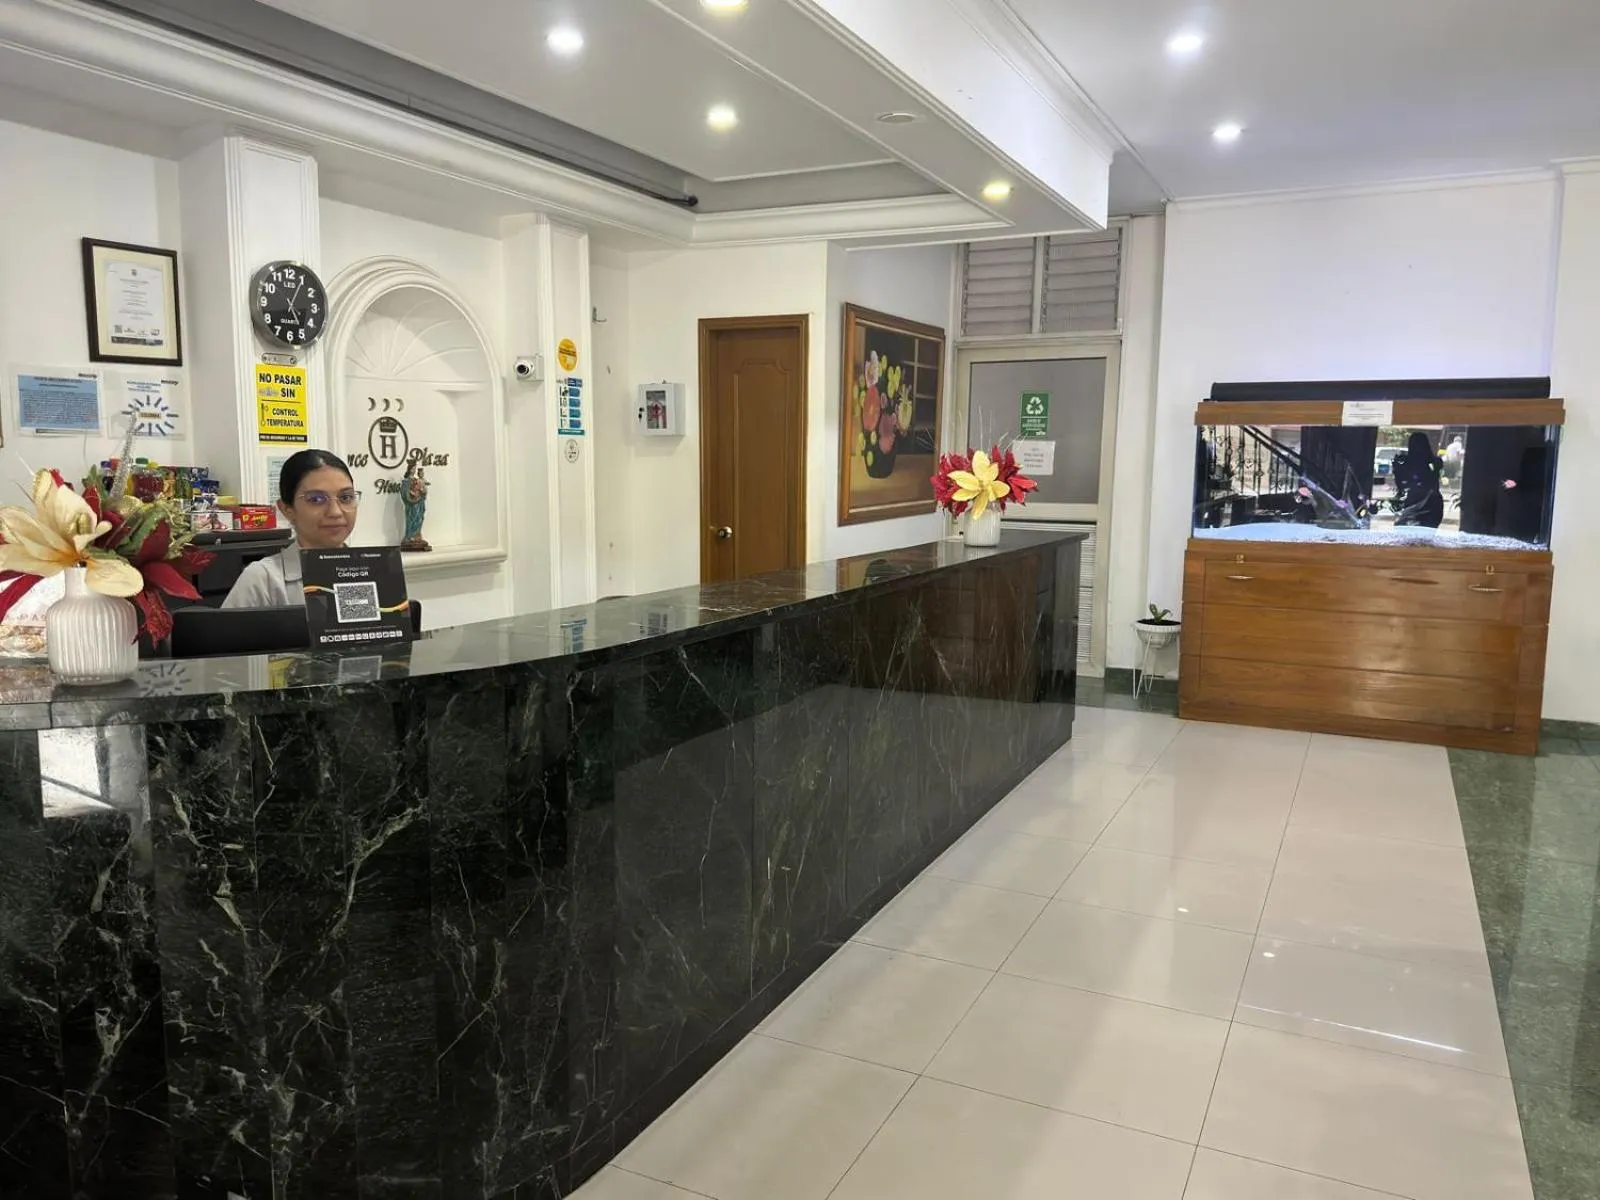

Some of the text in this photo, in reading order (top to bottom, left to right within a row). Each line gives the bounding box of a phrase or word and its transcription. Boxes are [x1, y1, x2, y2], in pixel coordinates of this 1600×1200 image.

[272, 271, 282, 282] 11
[283, 269, 296, 280] 12
[299, 275, 304, 285] 1
[264, 282, 276, 294] 10
[307, 287, 315, 298] 2
[260, 296, 268, 307] 9
[310, 303, 318, 314] 3
[264, 313, 272, 324] 8
[307, 318, 314, 328] 4
[274, 325, 282, 336] 7
[286, 330, 294, 341] 6
[298, 328, 305, 339] 5
[259, 372, 302, 386] NO PASAR
[280, 387, 296, 398] SIN
[272, 407, 299, 417] CONTROL
[266, 418, 304, 428] TEMPERATURA
[379, 434, 397, 459] H
